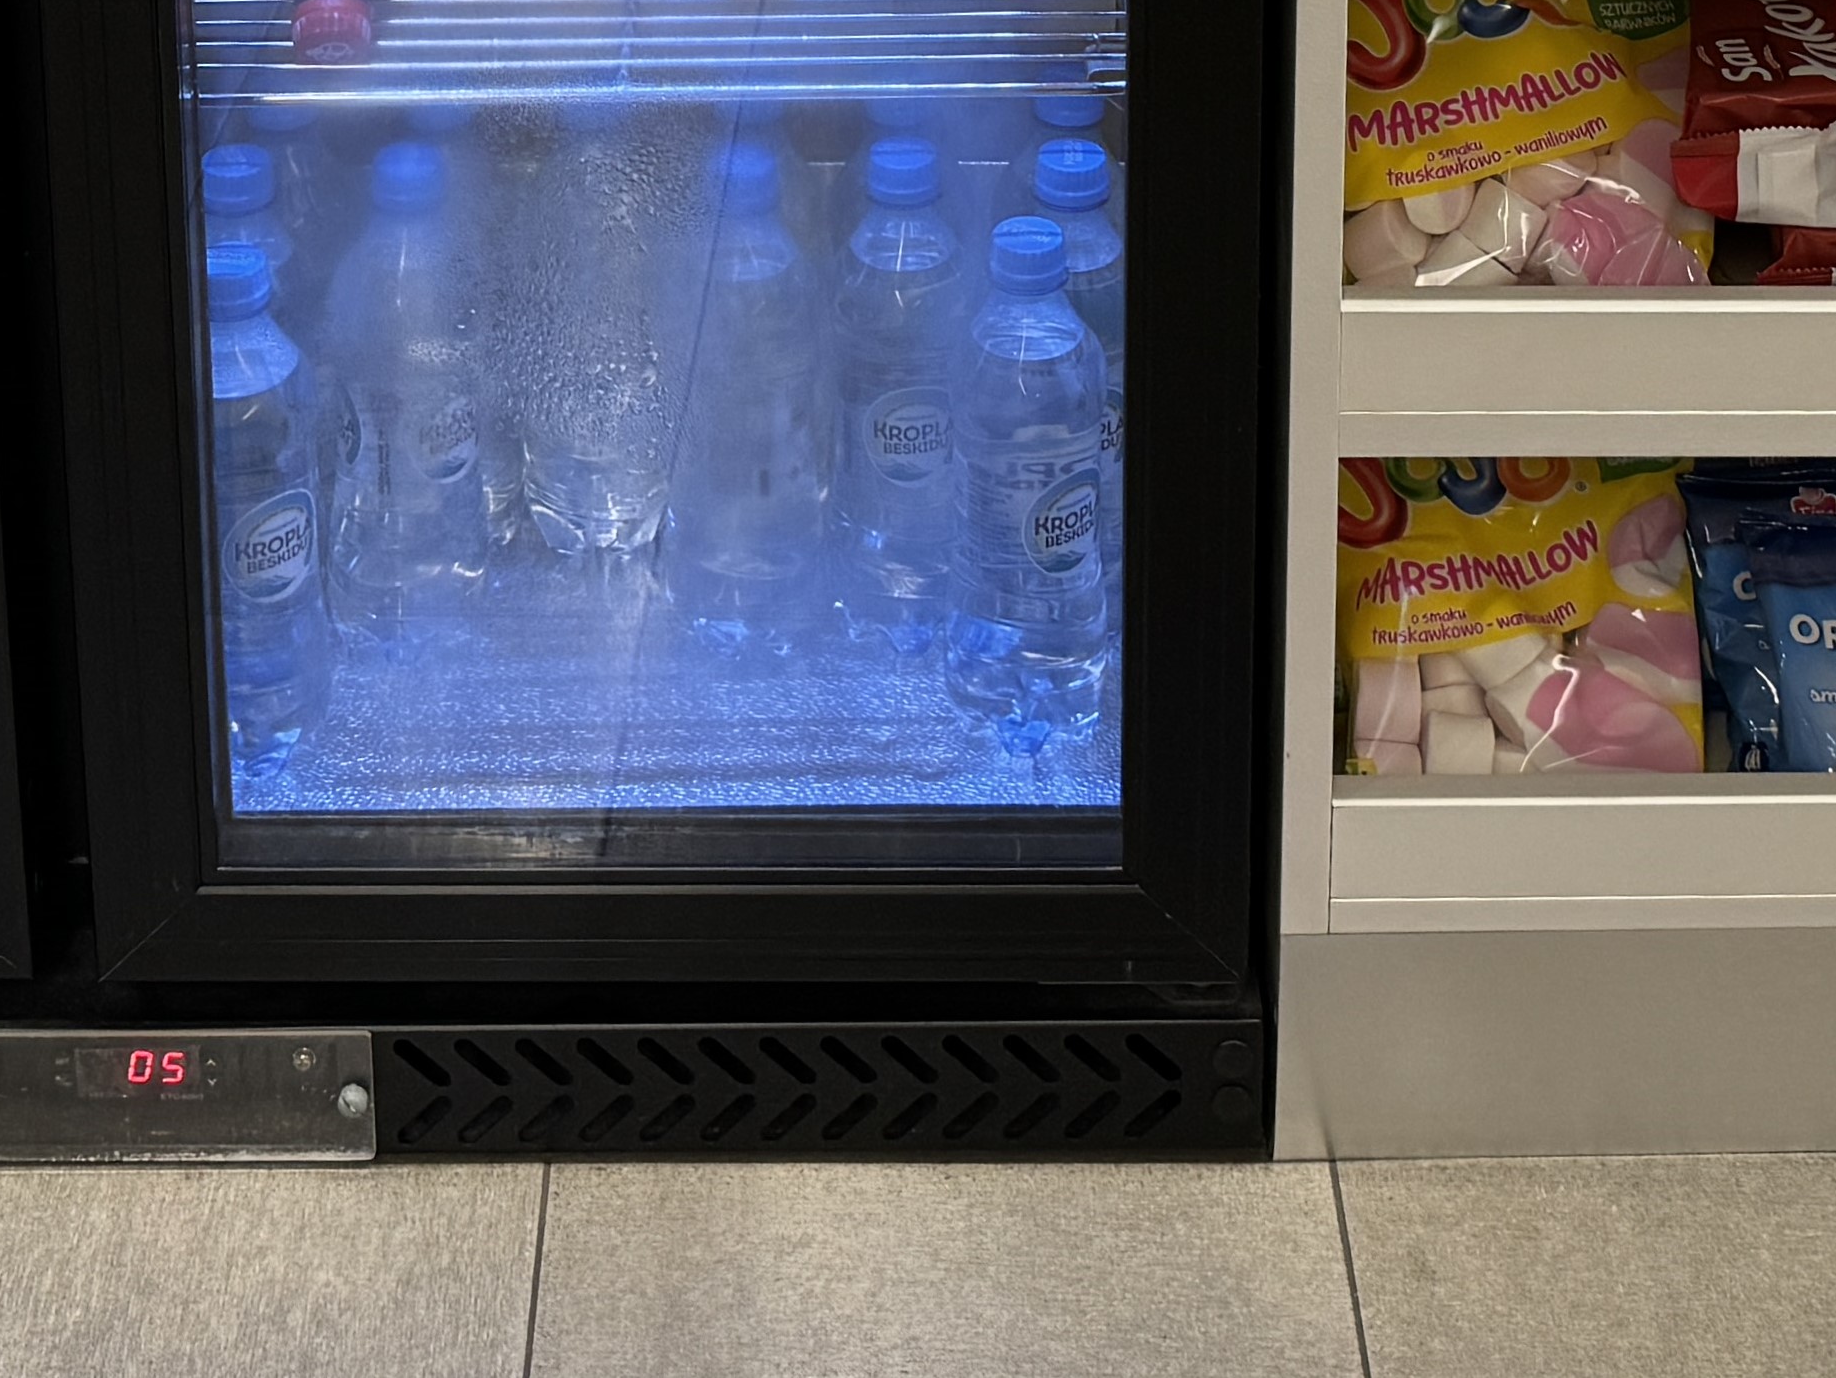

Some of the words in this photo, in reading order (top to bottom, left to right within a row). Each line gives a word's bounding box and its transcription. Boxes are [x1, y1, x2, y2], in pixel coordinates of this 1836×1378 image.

[1715, 38, 1772, 83] San
[1347, 49, 1627, 153] MARSHMALLOW
[1385, 155, 1503, 188] truskawkowo
[1512, 115, 1610, 158] waniliowym
[1438, 139, 1485, 160] smaku
[1355, 519, 1601, 613] MARSHMALLOW
[1371, 620, 1485, 646] truskawkowo
[1421, 607, 1469, 625] smaku
[127, 1049, 185, 1085] 05
